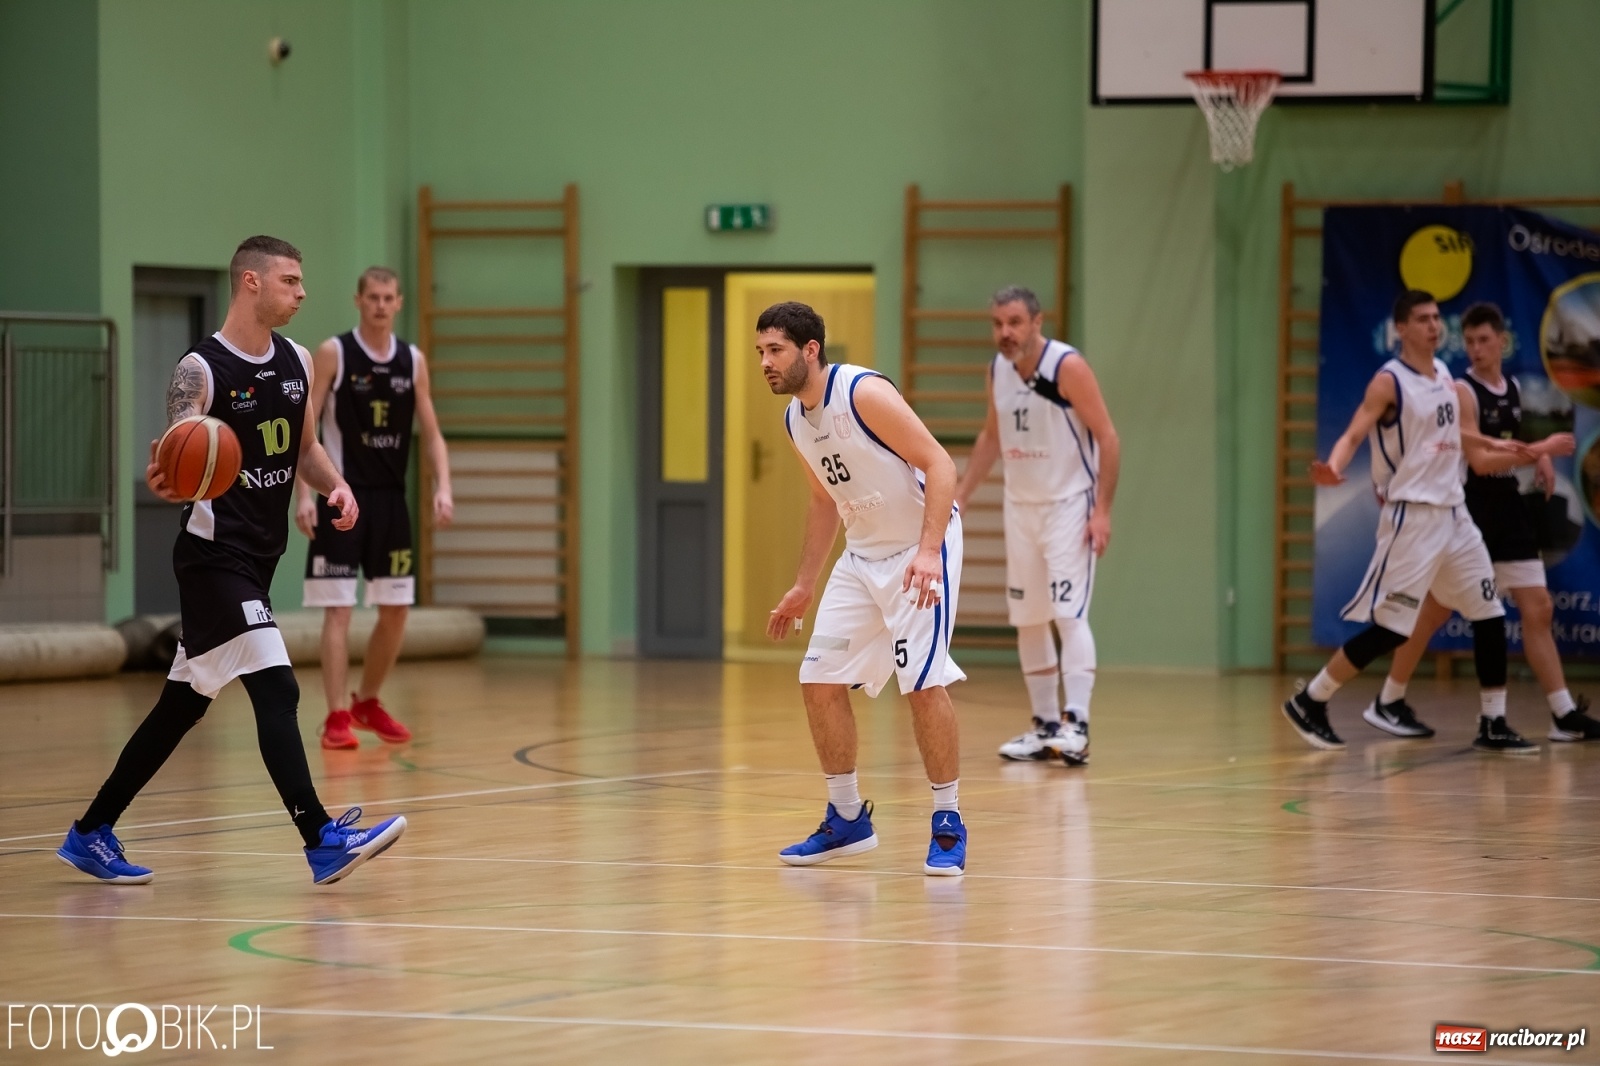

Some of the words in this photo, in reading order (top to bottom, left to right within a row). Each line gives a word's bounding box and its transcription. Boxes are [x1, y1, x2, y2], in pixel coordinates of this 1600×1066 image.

[231, 399, 258, 410] Cieszyn
[1437, 402, 1454, 428] 88
[257, 417, 290, 456] 10
[821, 453, 851, 485] 35
[389, 549, 412, 577] 15
[1050, 580, 1072, 602] 12
[1481, 578, 1496, 601] 8
[892, 638, 908, 668] 5
